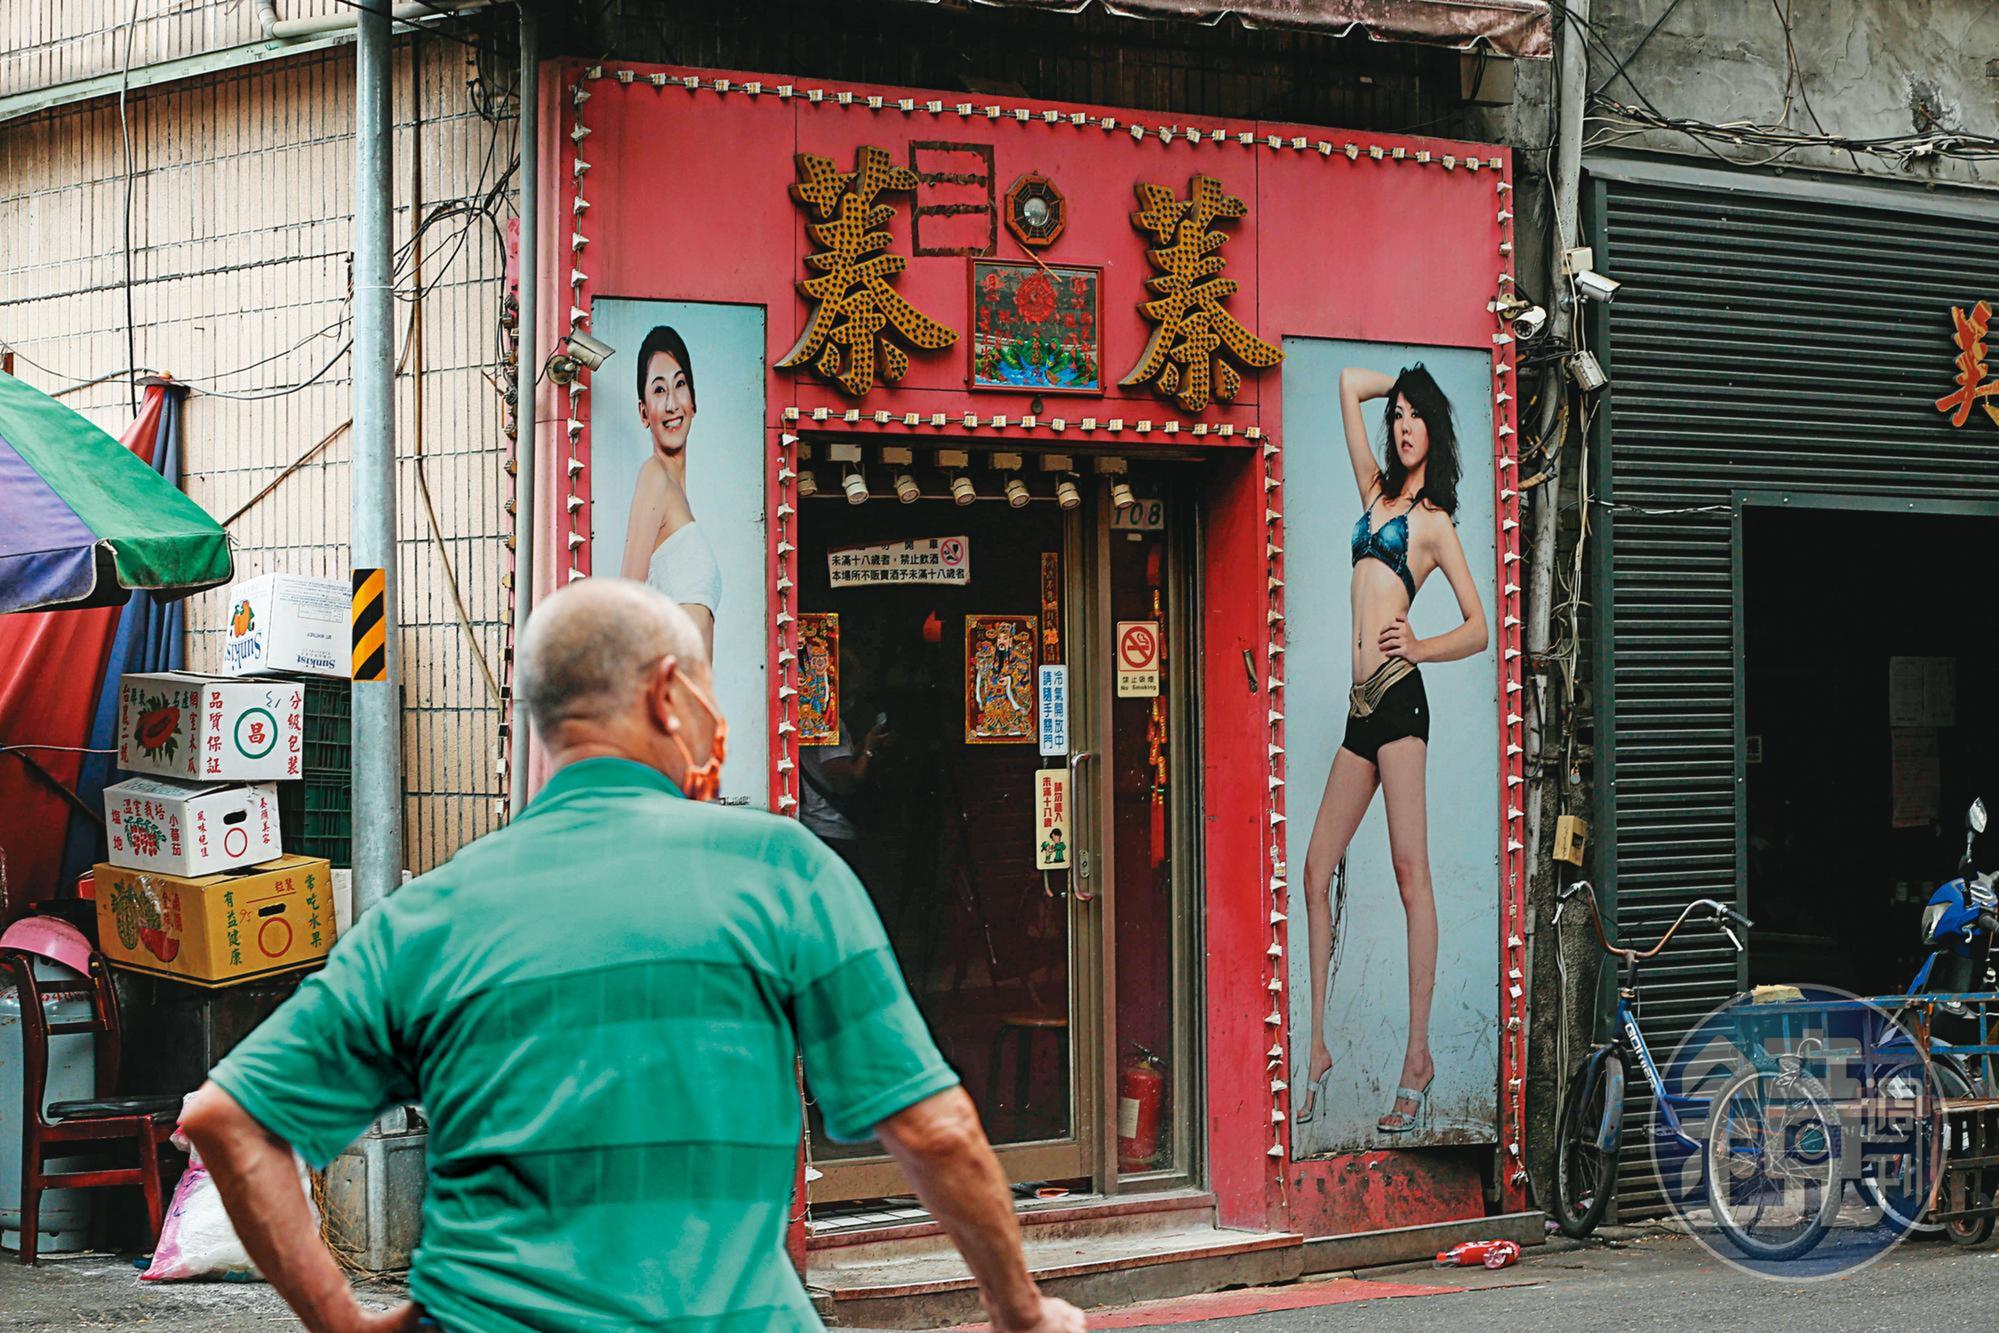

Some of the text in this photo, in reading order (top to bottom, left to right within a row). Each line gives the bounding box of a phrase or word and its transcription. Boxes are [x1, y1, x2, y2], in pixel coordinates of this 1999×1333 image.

[297, 655, 336, 669] Sunkist
[206, 691, 224, 774] 品質保証
[248, 722, 266, 744] 昌
[287, 690, 302, 775] 分級包裝
[1054, 671, 1064, 749] 冷氣開放中
[1043, 777, 1052, 827] 未滿十八歲
[224, 891, 242, 966] 有益健康
[305, 874, 322, 948] 常吃水果
